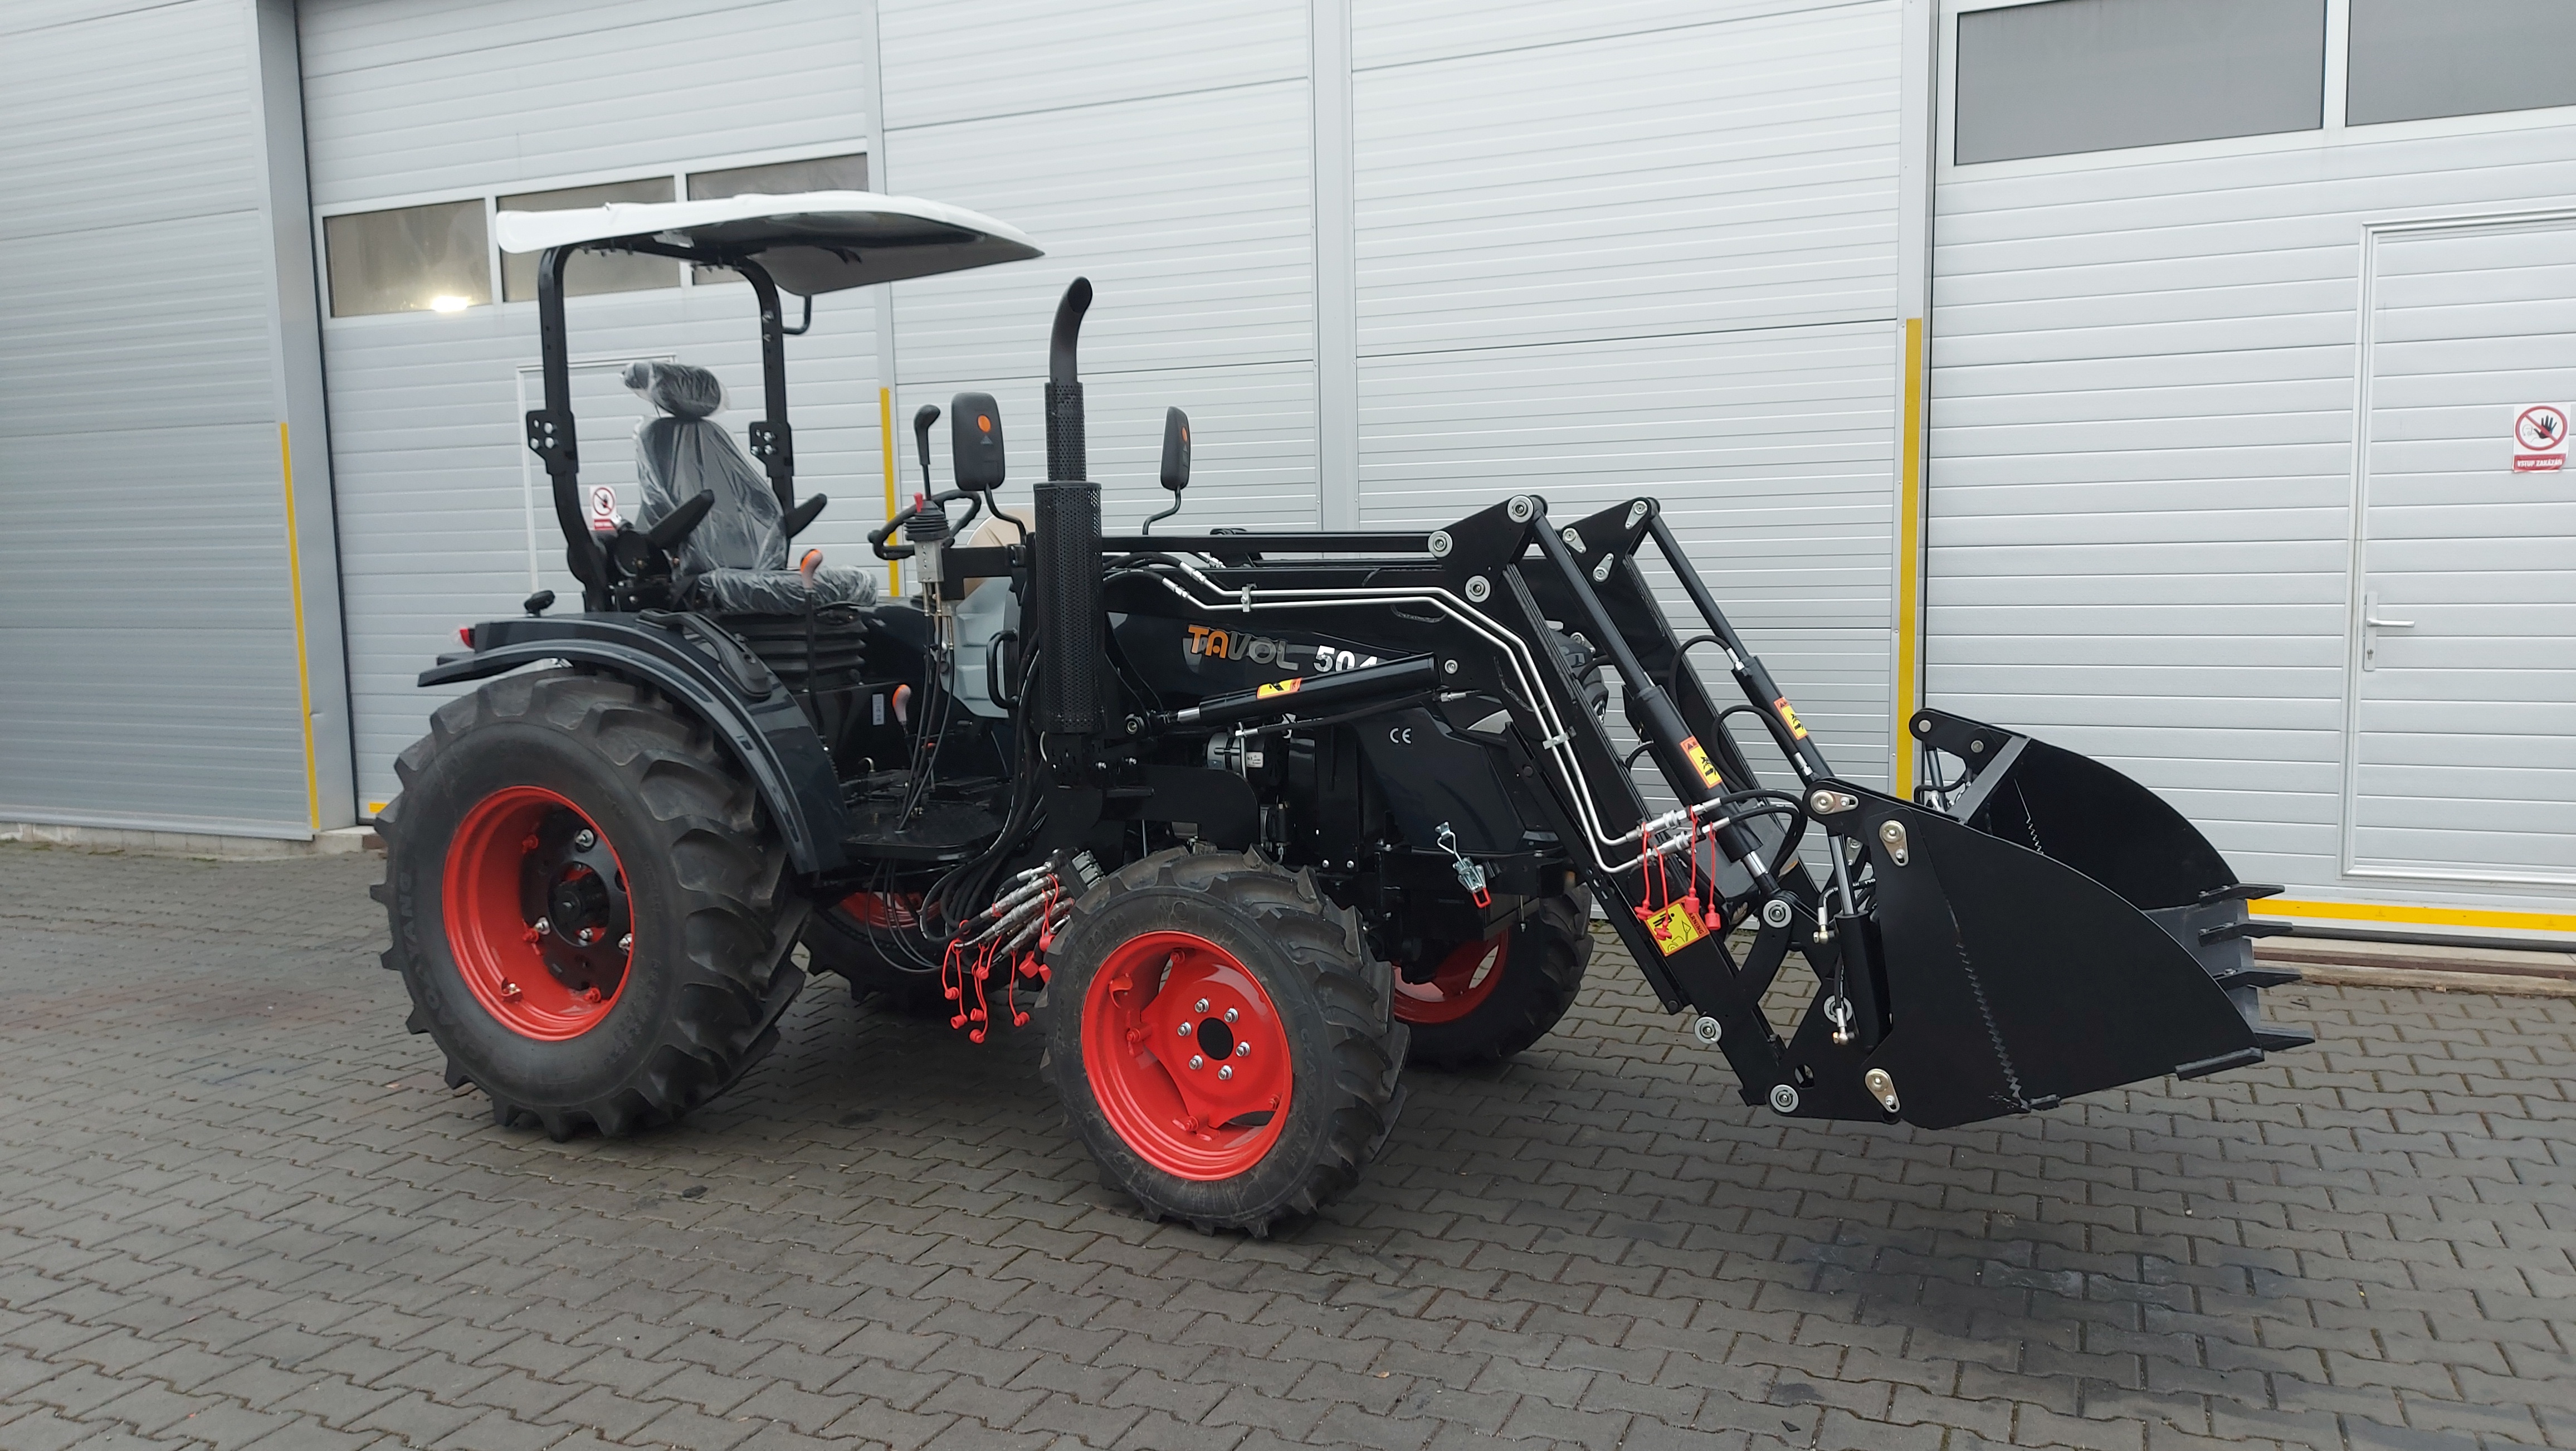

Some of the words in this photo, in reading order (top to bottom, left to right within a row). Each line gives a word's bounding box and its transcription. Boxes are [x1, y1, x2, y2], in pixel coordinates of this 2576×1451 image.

[1188, 625, 1299, 670] TAVOL
[1389, 728, 1411, 744] CE
[1688, 913, 1704, 934] ARNING
